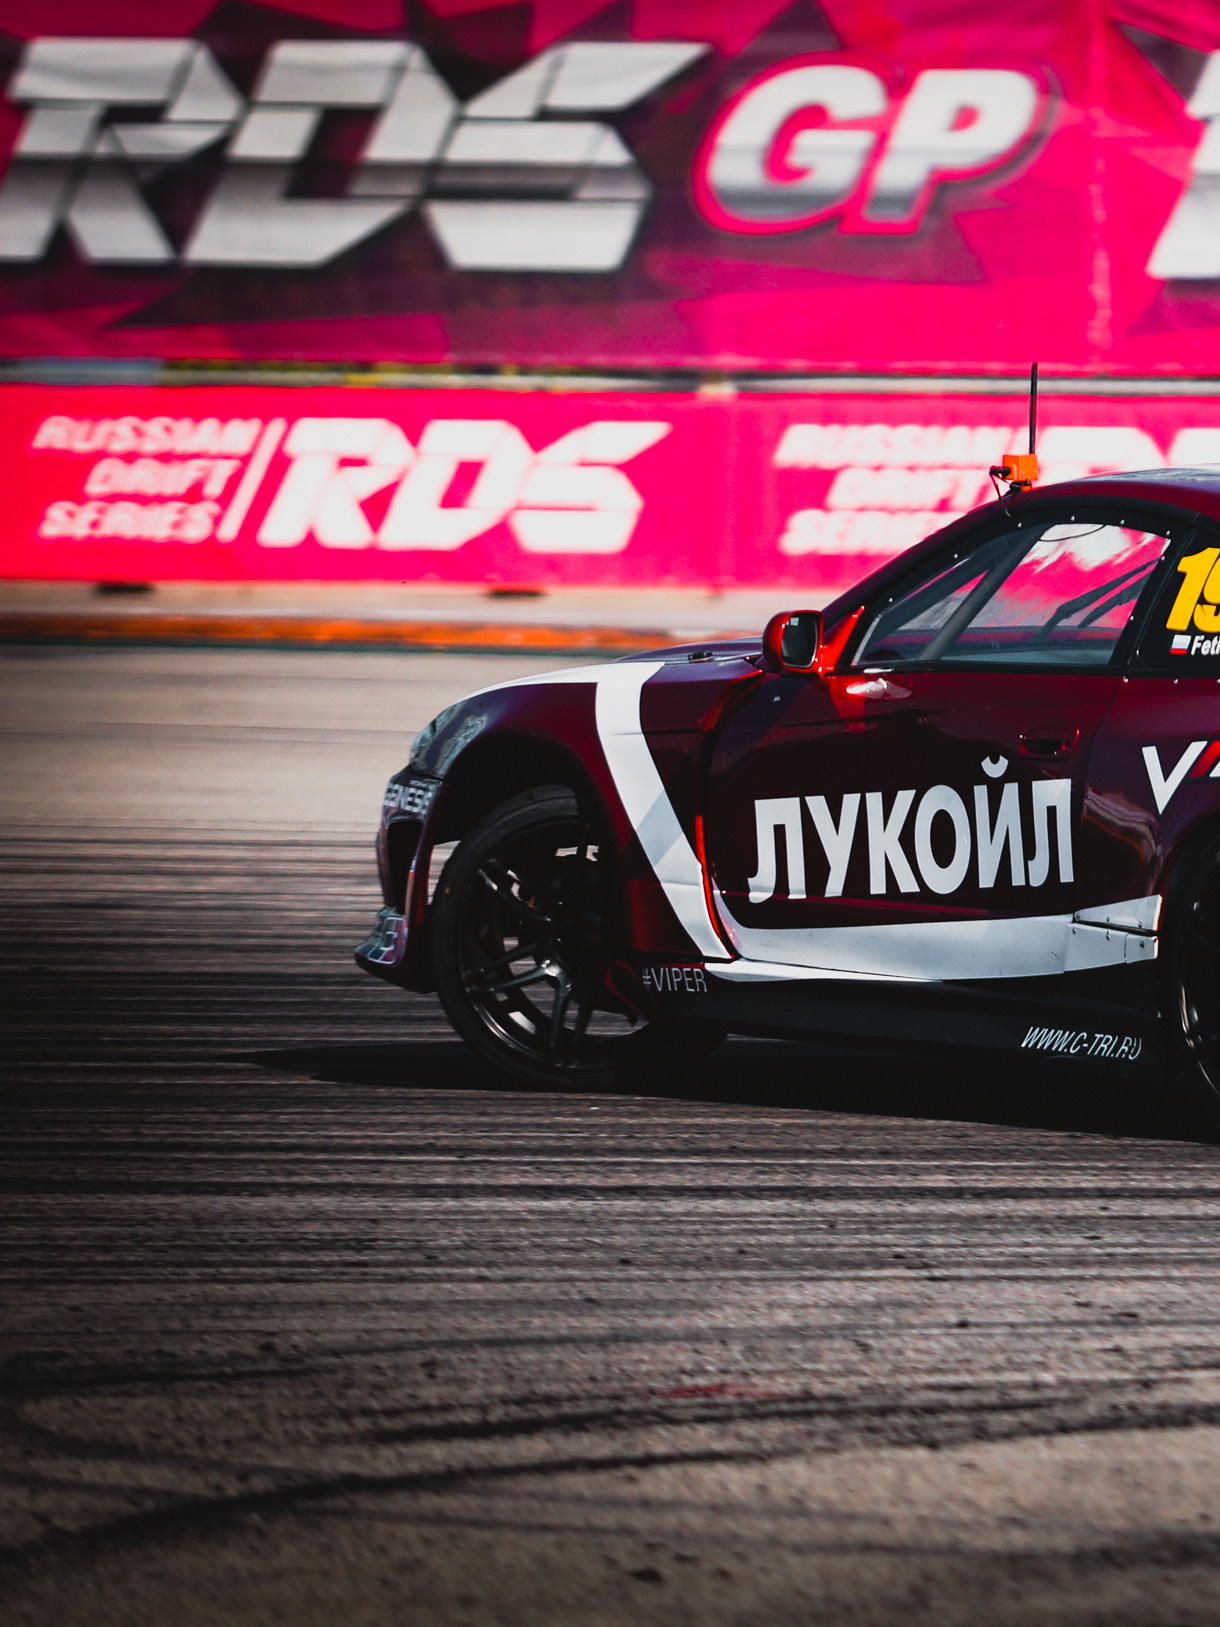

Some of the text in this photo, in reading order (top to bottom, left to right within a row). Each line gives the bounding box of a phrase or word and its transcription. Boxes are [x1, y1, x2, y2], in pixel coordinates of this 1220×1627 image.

[0, 36, 1041, 271] RDS GP
[30, 414, 261, 455] RUSSIAN
[84, 457, 241, 498] DRIFT
[256, 416, 673, 555] RDS
[36, 500, 222, 542] SERIES
[748, 755, 1075, 903] ЛУКОЙЛ
[642, 967, 708, 993] #VIPER
[1020, 1026, 1142, 1061] WWW.C-TRI.RU
